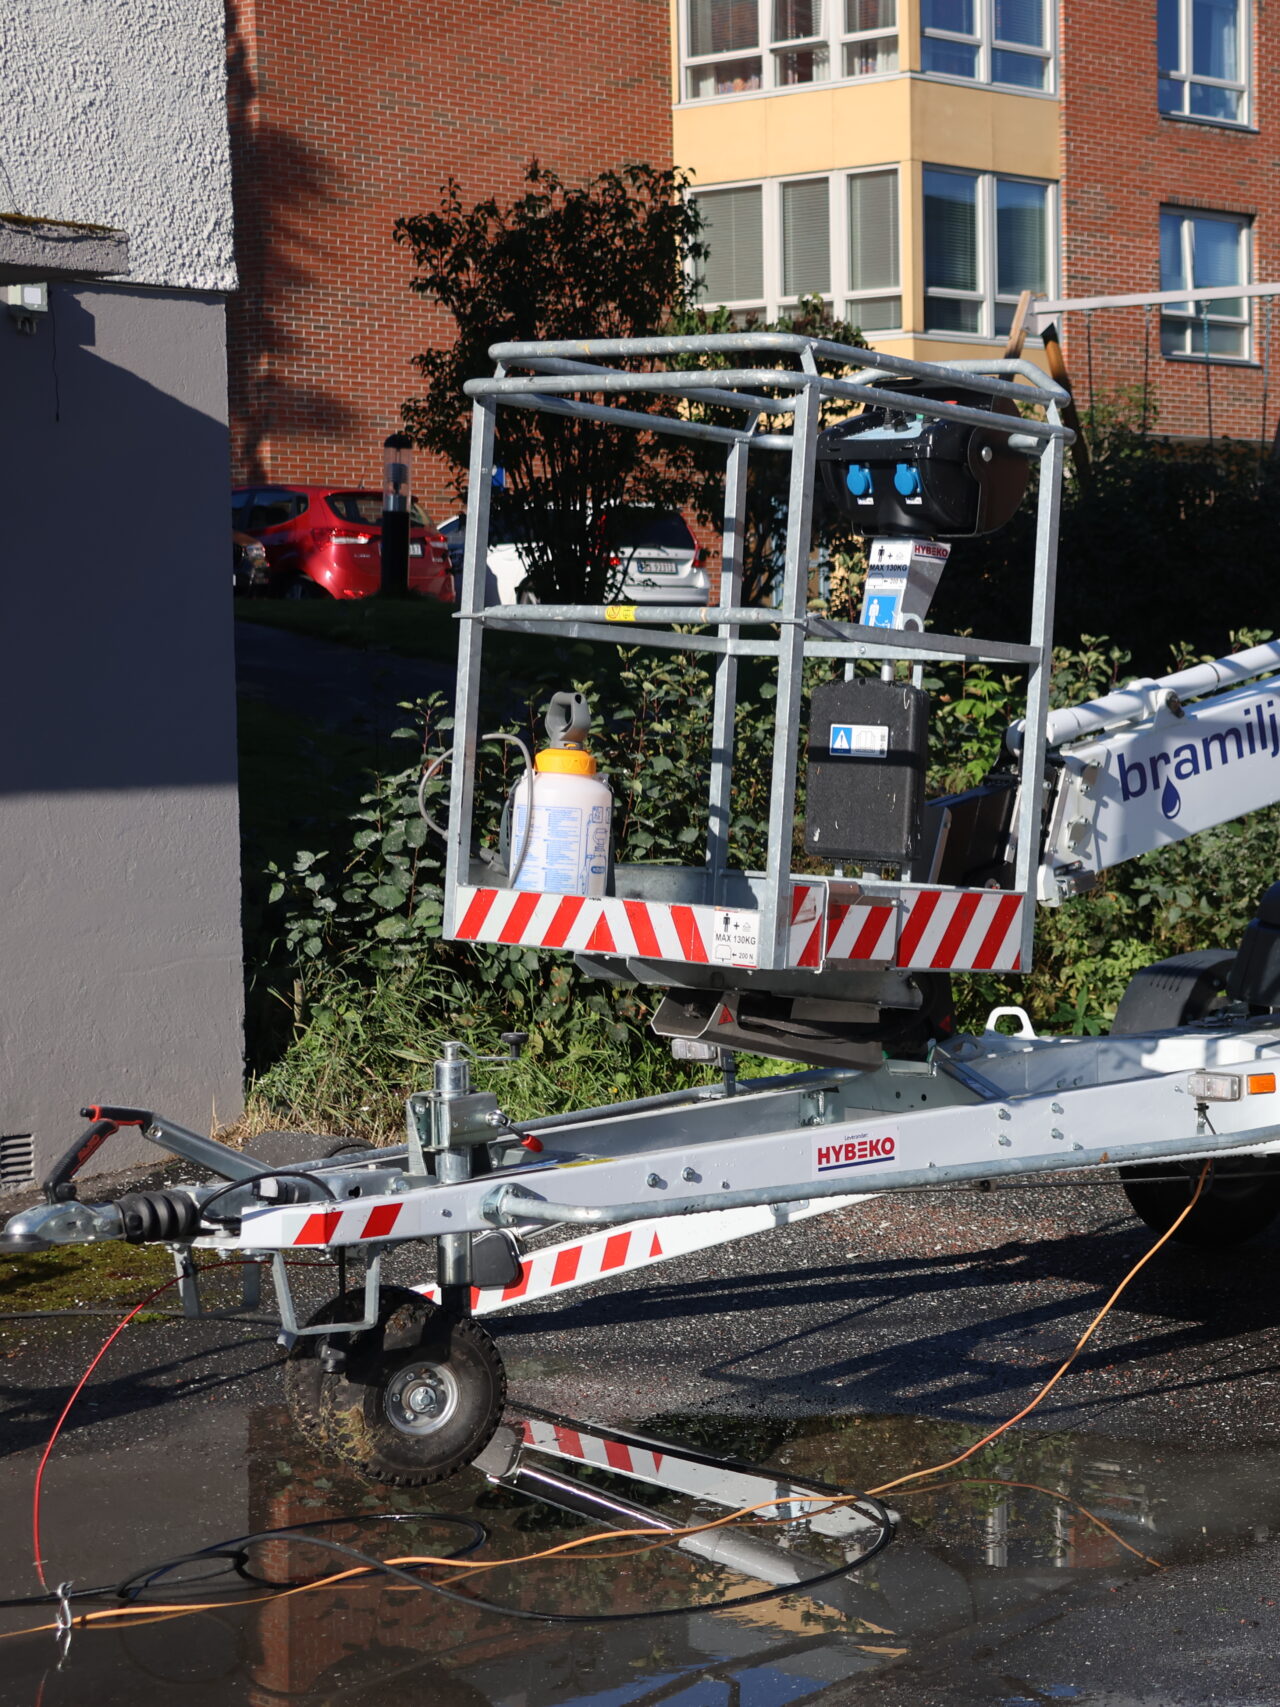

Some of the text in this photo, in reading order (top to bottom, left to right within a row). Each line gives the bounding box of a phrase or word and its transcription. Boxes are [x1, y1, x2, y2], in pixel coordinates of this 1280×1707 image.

[914, 545, 948, 557] HYBEKO
[716, 934, 756, 944] MAX 130KG
[818, 1137, 894, 1165] HYBEKO
